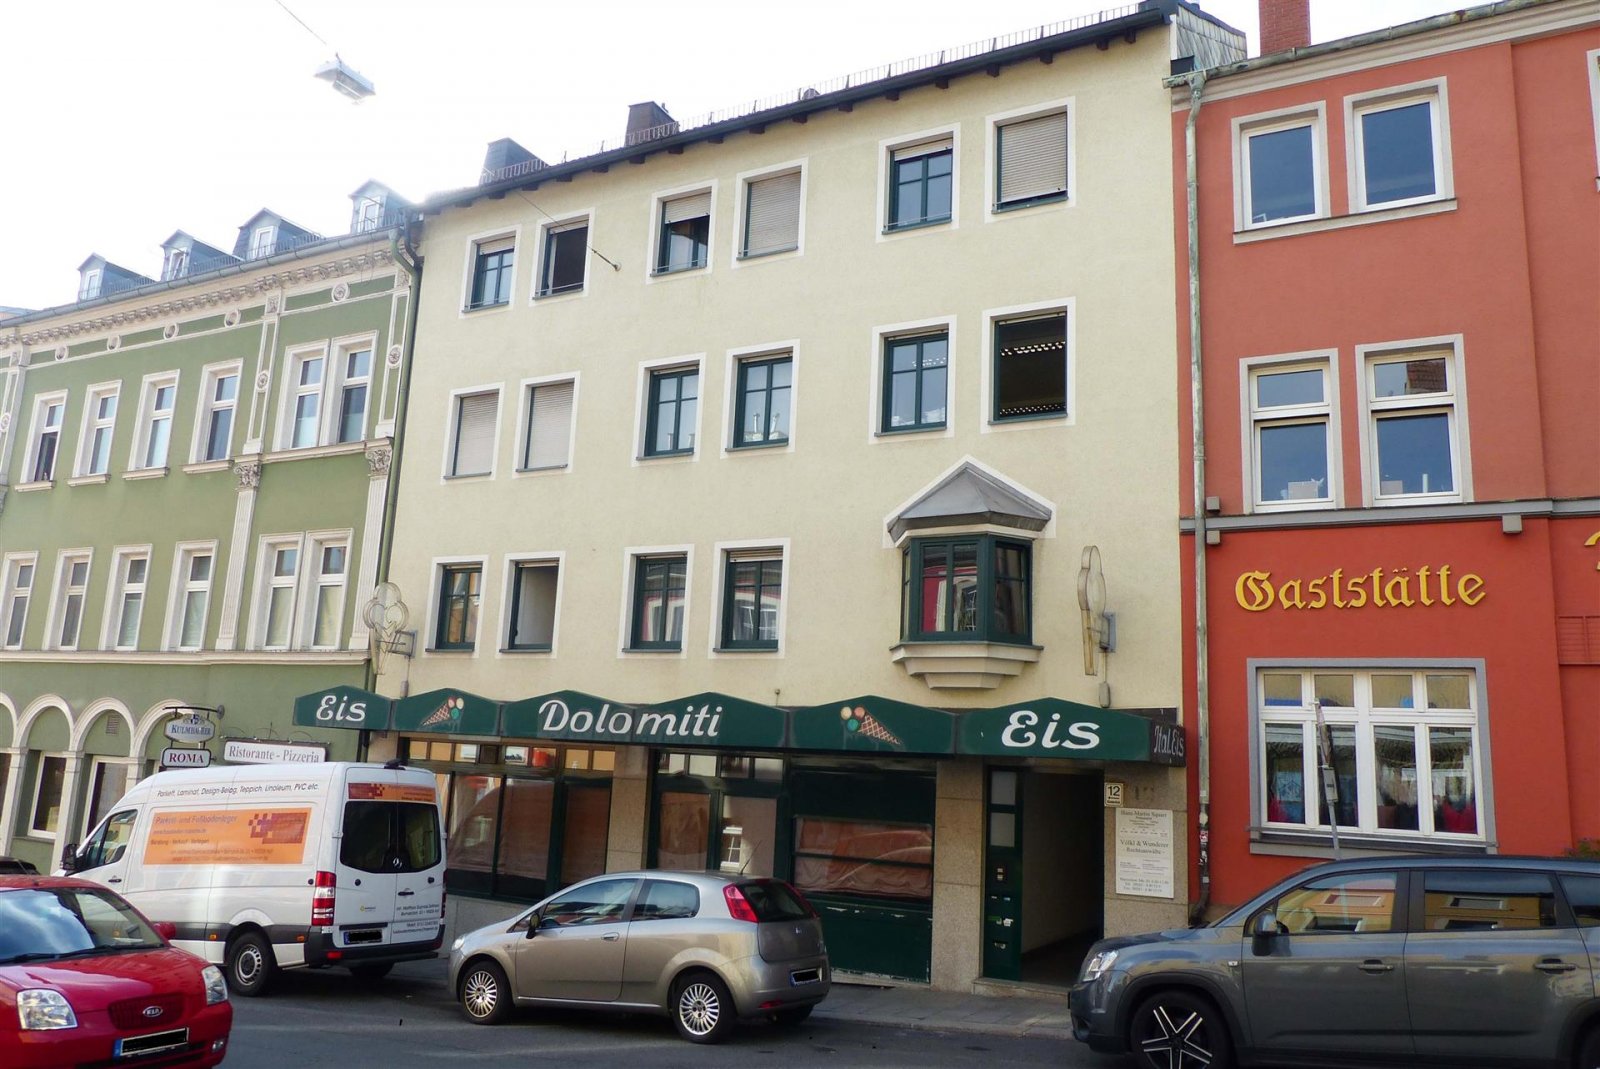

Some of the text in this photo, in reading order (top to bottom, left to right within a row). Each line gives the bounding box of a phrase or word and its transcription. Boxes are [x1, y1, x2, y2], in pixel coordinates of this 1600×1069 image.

[1235, 564, 1487, 611] Gaststätte
[316, 695, 367, 722] Eis
[539, 699, 724, 738] Dolomiti
[1001, 710, 1100, 750] Eis
[169, 752, 204, 763] ROMA
[229, 745, 275, 760] Ristorante
[282, 749, 320, 763] Pizzeria
[1107, 785, 1121, 796] 12
